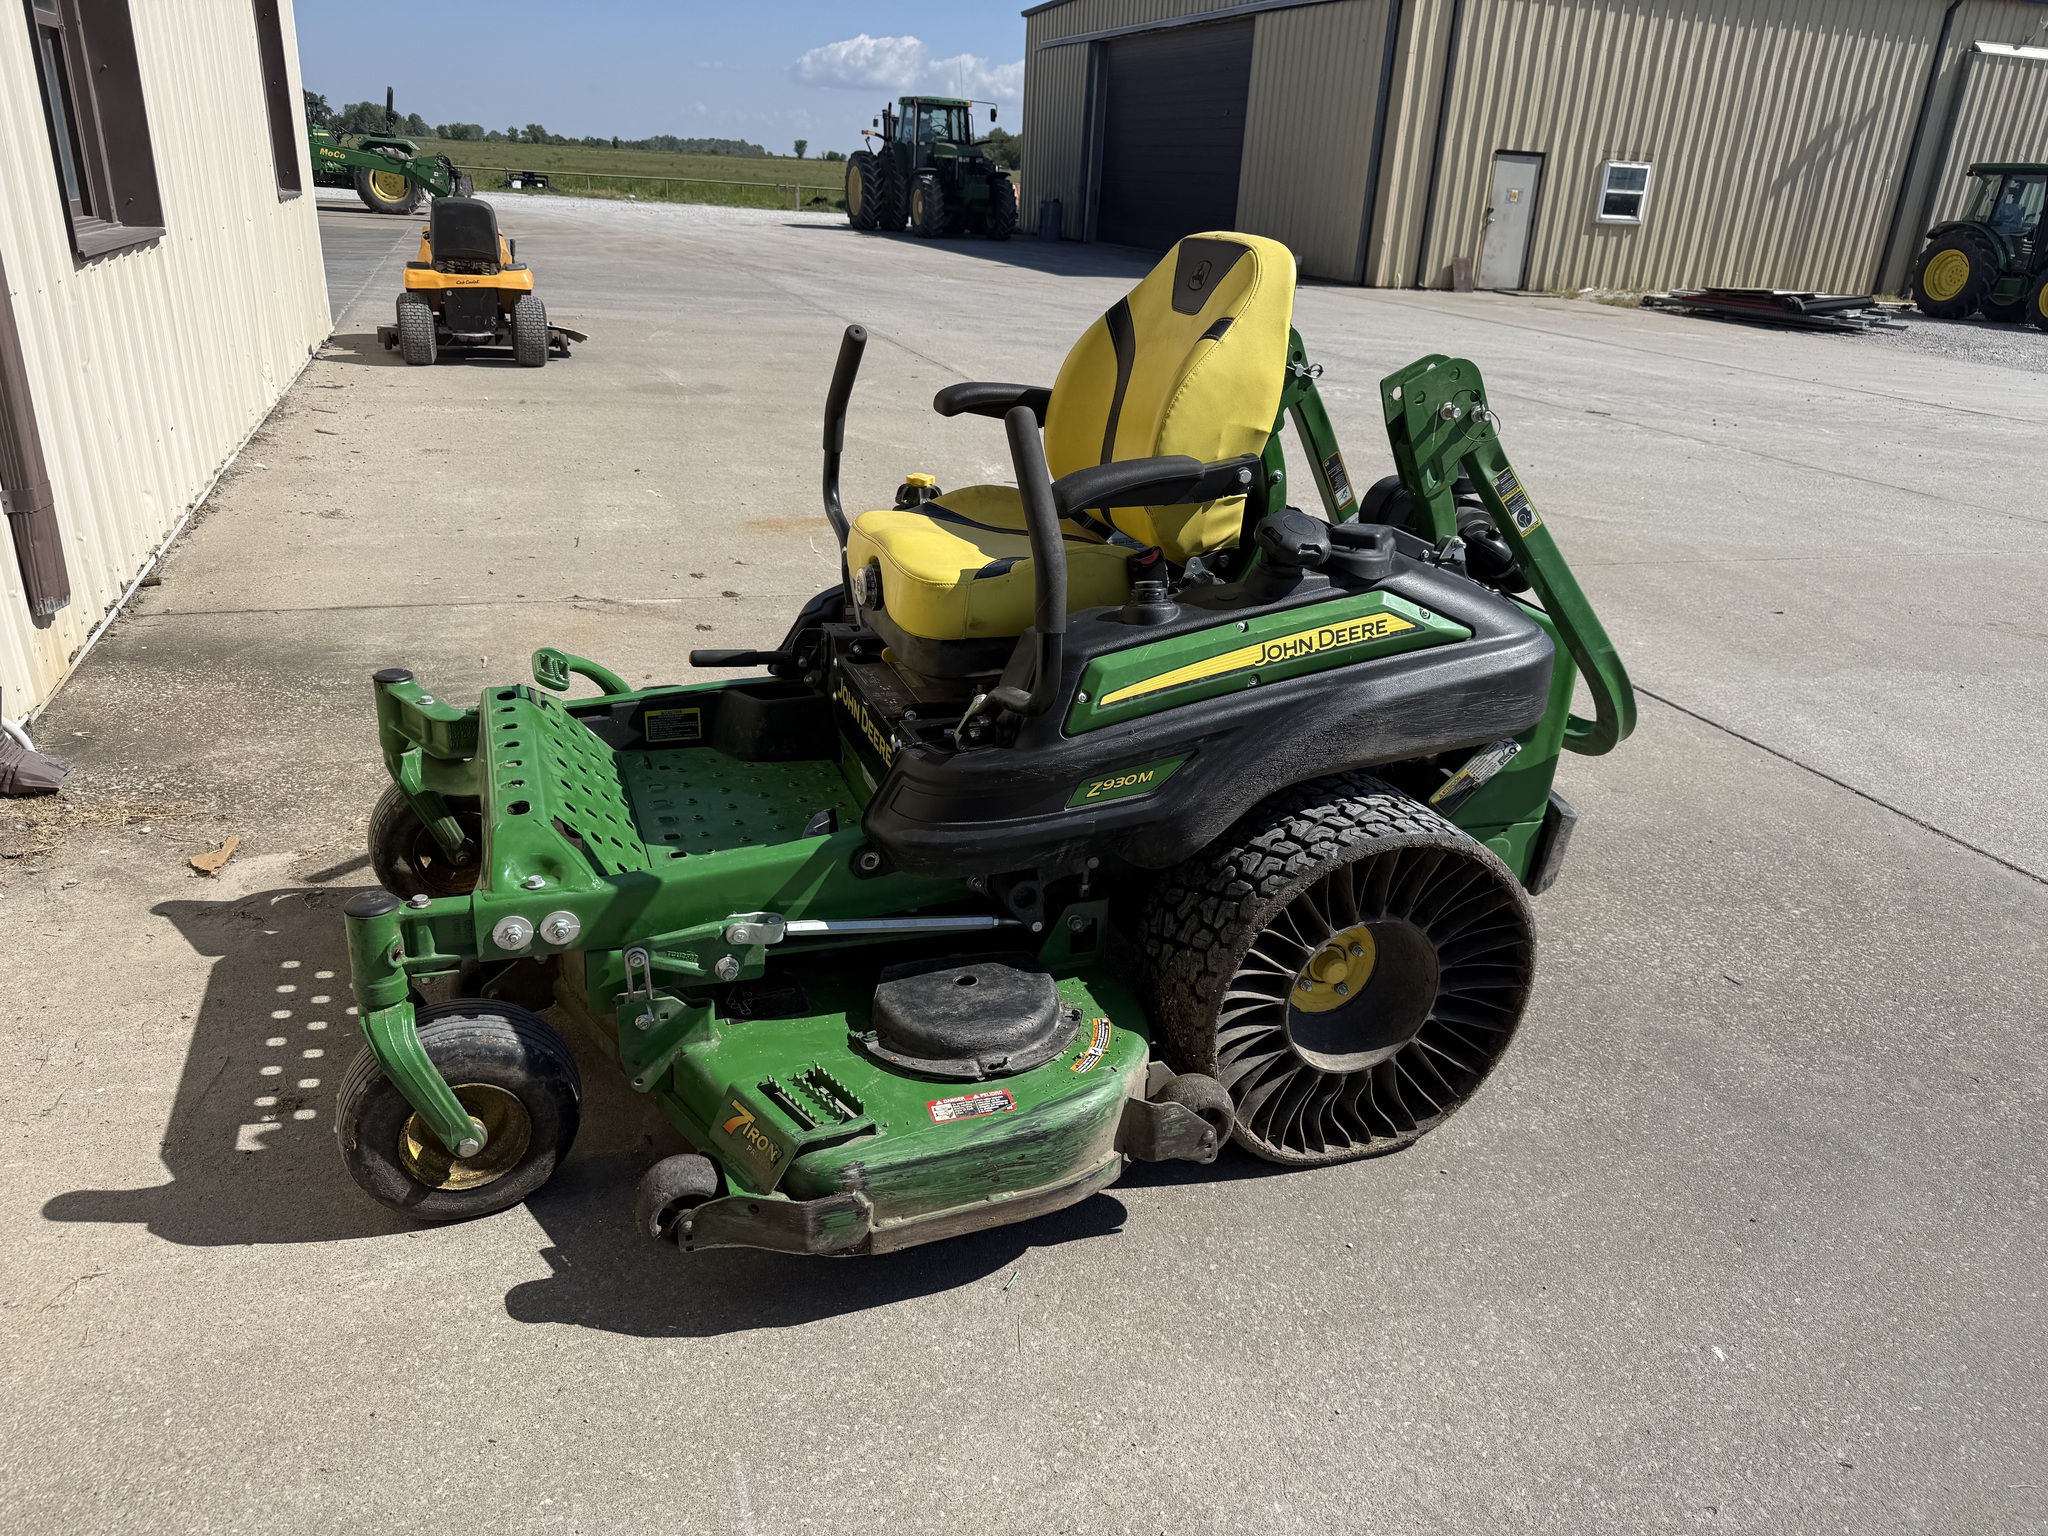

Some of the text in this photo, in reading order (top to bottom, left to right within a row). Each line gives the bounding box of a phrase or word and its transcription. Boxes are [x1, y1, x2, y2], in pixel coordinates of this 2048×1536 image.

[320, 147, 346, 159] MoCo
[1254, 618, 1388, 665] JOHN DEERE
[838, 677, 860, 724] JOHN
[861, 706, 893, 769] DEERE
[1086, 770, 1155, 798] Z930M
[943, 1090, 1003, 1104] DANGER PELIGRO
